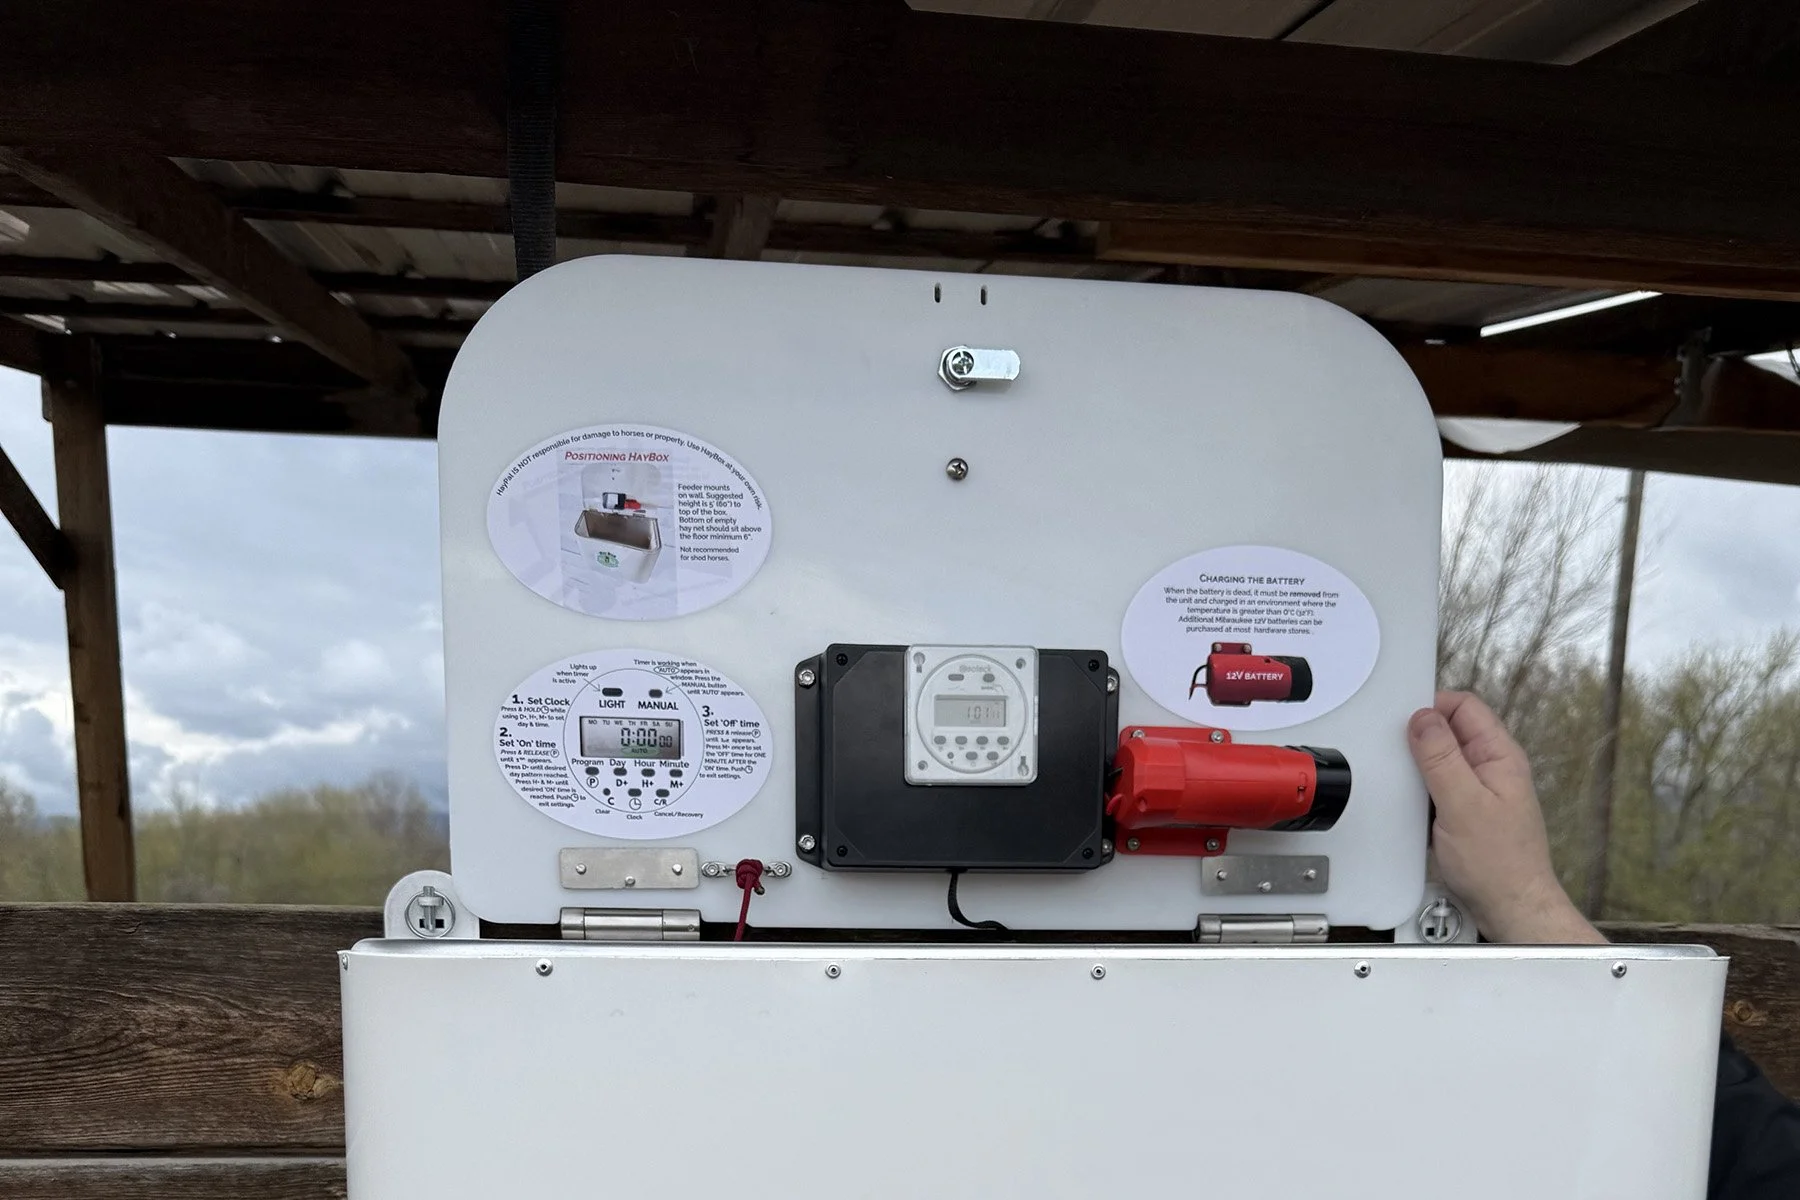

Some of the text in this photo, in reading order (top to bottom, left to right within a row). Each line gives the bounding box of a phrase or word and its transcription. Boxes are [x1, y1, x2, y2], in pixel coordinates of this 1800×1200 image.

[512, 467, 519, 476] IS
[518, 456, 533, 469] NOT
[532, 439, 570, 459] responsible
[582, 431, 611, 441] damage
[655, 433, 685, 446] property.
[687, 441, 700, 451] Use
[701, 447, 725, 464] HayBox
[731, 467, 746, 481] your
[744, 481, 755, 495] own
[1209, 598, 1238, 606] charged
[1226, 671, 1283, 681] 12V BATTERY
[512, 694, 524, 704] 1.
[544, 698, 570, 706] Clock
[599, 700, 678, 710] LIGHT MANUAL
[702, 705, 714, 717] 3.
[704, 719, 719, 727] Set
[500, 727, 512, 737] 2.
[500, 739, 514, 747] Set
[536, 740, 556, 748] time
[609, 759, 626, 768] Day
[660, 760, 689, 768] Minute
